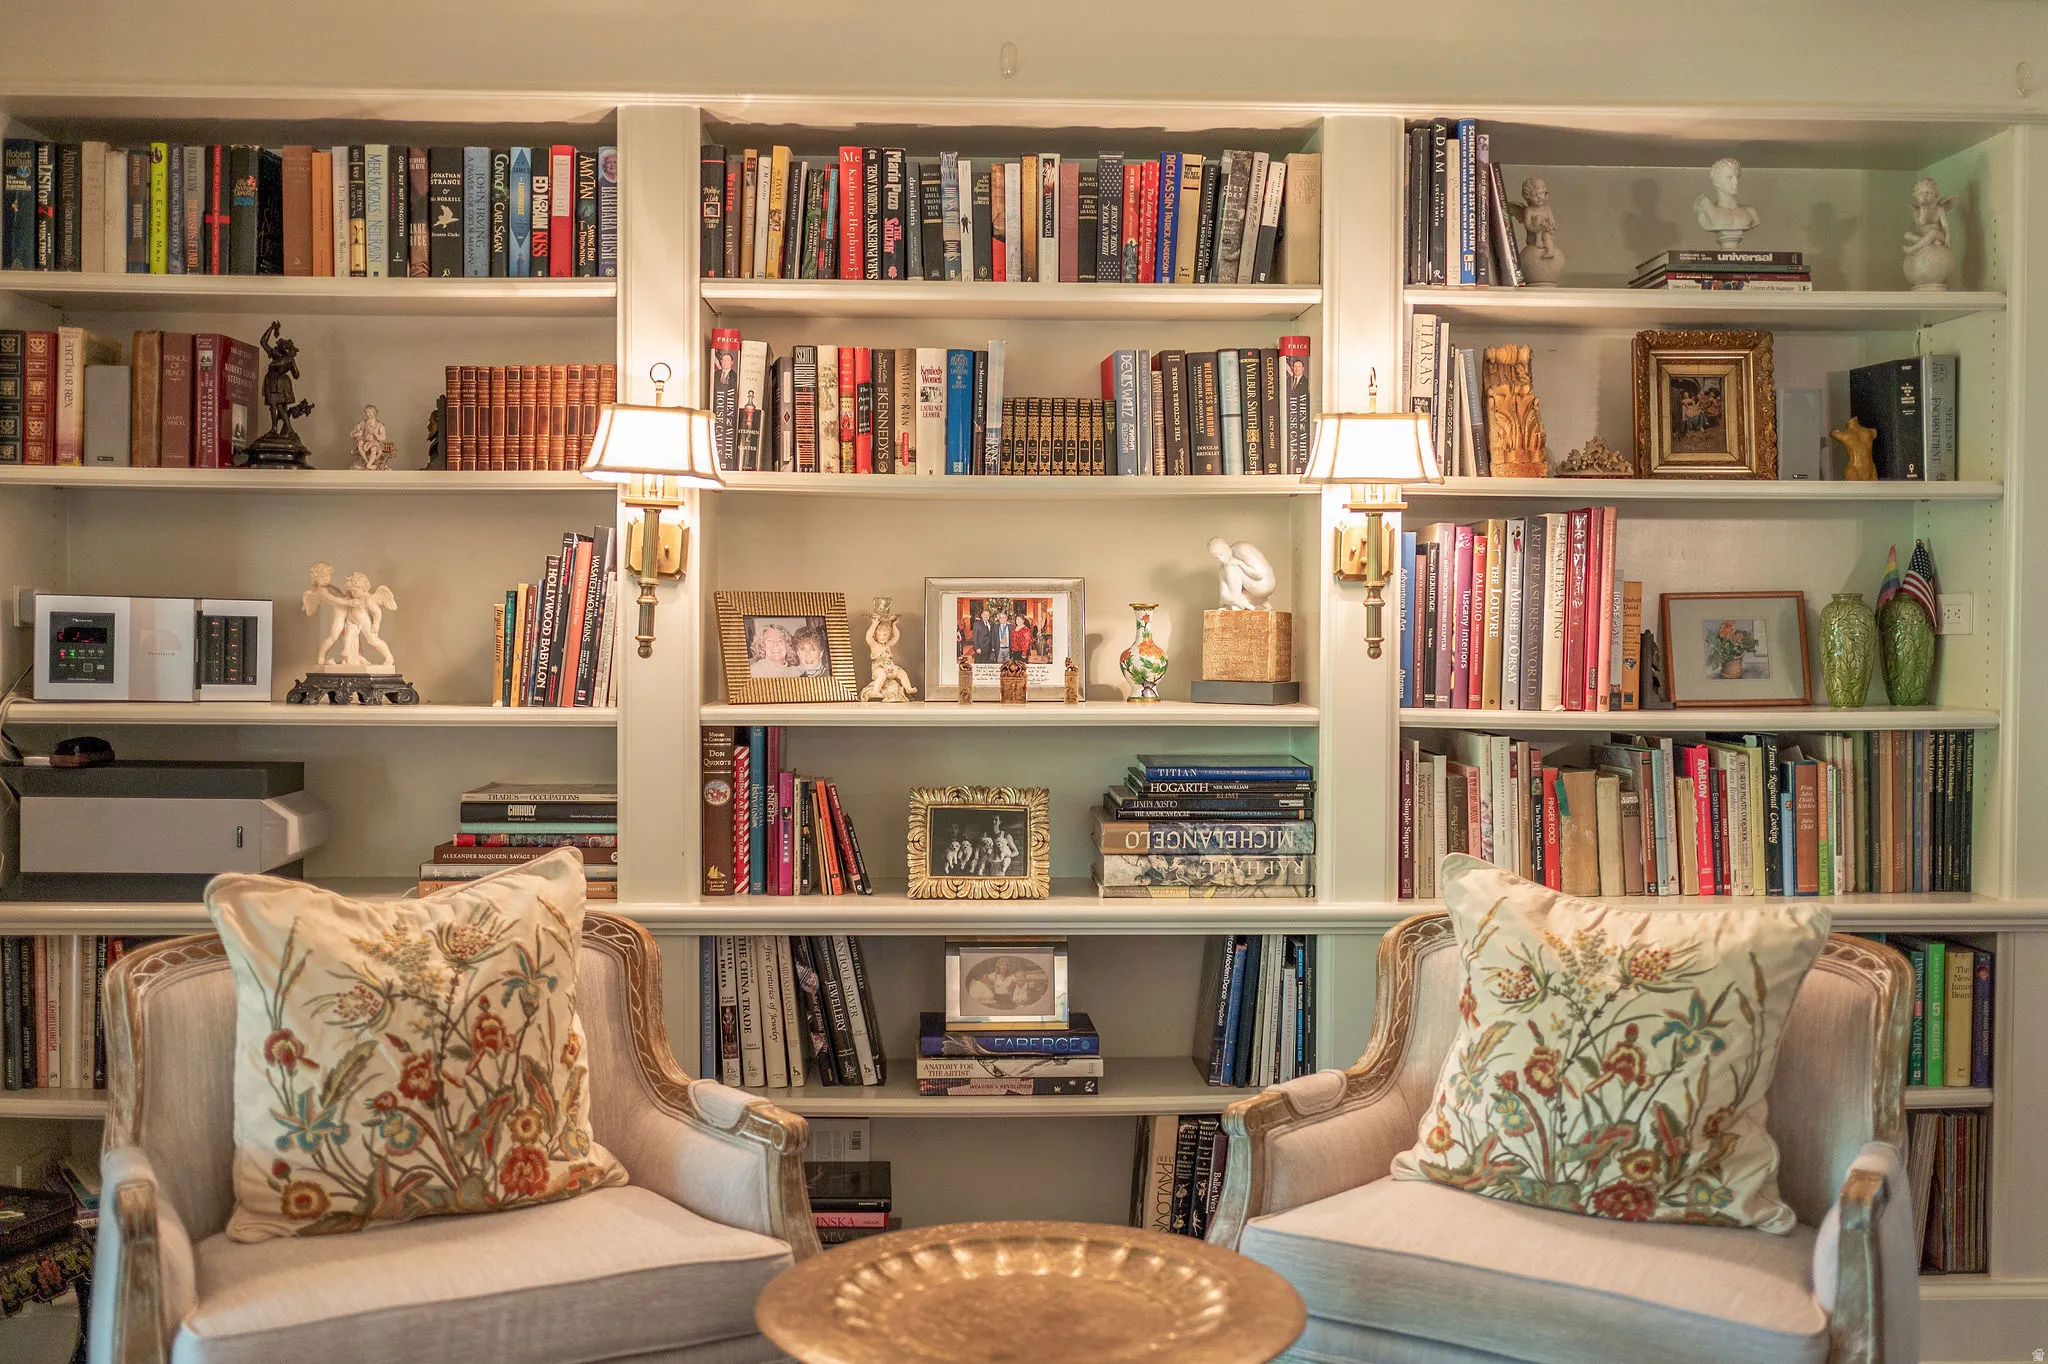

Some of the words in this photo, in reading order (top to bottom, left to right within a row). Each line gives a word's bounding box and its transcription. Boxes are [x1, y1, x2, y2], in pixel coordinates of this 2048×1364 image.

[39, 146, 48, 164] THE
[843, 152, 861, 163] Me
[1435, 124, 1446, 173] ADAM
[39, 164, 53, 191] LIST
[367, 155, 384, 175] MERE
[579, 156, 595, 178] AMY
[867, 164, 878, 184] ANGEL
[885, 151, 901, 182] Mario
[1165, 154, 1177, 179] RICH
[39, 191, 48, 205] OF
[367, 177, 384, 213] MORTALS
[475, 173, 486, 202] JOHN
[532, 176, 548, 192] ED
[579, 179, 595, 199] TAN
[726, 173, 735, 211] Waiting
[848, 169, 857, 216] Katharine
[885, 184, 901, 210] Puzo
[1164, 180, 1176, 192] AS
[38, 205, 53, 217] 7
[494, 202, 505, 224] CARL
[867, 184, 878, 214] GUARDIAN
[1163, 192, 1175, 209] SIN
[39, 220, 47, 240] MARK
[367, 220, 384, 237] NEIL
[475, 208, 486, 248] IRVING
[726, 226, 733, 238] HA
[867, 219, 878, 257] PARETSKY
[884, 218, 898, 253] SICILIAN
[894, 225, 902, 240] THE
[1163, 211, 1174, 237] PATRICK
[39, 241, 47, 265] FROST
[367, 239, 384, 263] RAVIN
[494, 225, 506, 253] SAGAN
[532, 231, 548, 257] KISS
[846, 218, 858, 264] Hepburn
[867, 260, 878, 279] SARA
[1162, 238, 1172, 274] ANDERSON
[1717, 253, 1773, 262] universal
[1420, 321, 1434, 385] TIARAS
[794, 364, 816, 388] TUROW
[1171, 367, 1179, 391] HORSE
[1204, 362, 1214, 404] WILDERNESS
[1245, 363, 1257, 399] WILBUR
[1266, 357, 1274, 402] CLEOPATRA
[715, 391, 724, 423] HOUSE
[725, 389, 734, 417] WHEN
[795, 392, 815, 404] THE
[1121, 389, 1134, 418] WALTZ
[1173, 393, 1181, 425] OCTOBER
[1299, 394, 1307, 422] WHEN
[795, 405, 815, 433] BURDEN
[877, 392, 888, 459] KENNEDYS
[901, 404, 911, 426] RAIN
[1206, 406, 1215, 437] WARRIOR
[1247, 401, 1258, 429] SMITH
[1290, 397, 1298, 429] HOUSE
[724, 429, 733, 459] WHITE
[1931, 397, 1942, 463] ENCHANTMENT
[1248, 443, 1257, 471] QUEST
[1290, 431, 1298, 460] CALLS
[1299, 433, 1307, 464] WHITE
[1531, 524, 1541, 552] ART
[588, 555, 600, 593] WASATCH
[1400, 568, 1408, 608] Adventure
[1490, 564, 1500, 584] THE
[1511, 565, 1519, 585] THE
[543, 568, 558, 635] HOLLYWOOD
[1428, 572, 1436, 612] HERMITAGE
[1474, 572, 1484, 621] PALLADIO
[1528, 554, 1541, 630] TREASURES
[583, 593, 596, 642] MOUNTAINS
[1400, 609, 1407, 617] in
[1460, 589, 1471, 627] Tuscany
[1488, 588, 1502, 638] LOUVRE
[536, 638, 551, 688] BABYLON
[1460, 629, 1470, 669] Interiors
[1527, 645, 1538, 696] WORLD
[1768, 745, 1777, 771] French
[1150, 782, 1209, 792] HOGARTH
[1157, 769, 1197, 777] TITIAN
[1697, 758, 1707, 798] MARION
[767, 785, 775, 824] KNIGHT
[1768, 774, 1778, 809] Regional
[508, 804, 537, 816] CHIHULY
[1403, 798, 1411, 825] Simple
[1534, 814, 1542, 831] Paley's
[1125, 831, 1294, 849] MICHELANGELO
[1548, 823, 1556, 844] FOOD
[1769, 812, 1779, 844] Cooking
[1403, 827, 1411, 859] Suppers
[1203, 860, 1305, 875] RAPHAEL
[738, 937, 746, 958] THE
[763, 945, 774, 962] Five
[739, 961, 749, 995] CHINA
[835, 939, 851, 982] ANTIQUE
[846, 985, 859, 1018] SILVER
[1222, 954, 1233, 980] Modern
[766, 965, 776, 1000] Centuries
[1221, 979, 1230, 999] Dance
[742, 997, 752, 1034] TRADE
[767, 1003, 778, 1011] of
[825, 979, 847, 1031] JEWELLERY
[1932, 1001, 1941, 1017] 5
[48, 1000, 57, 1051] EXHIBITIONISM
[769, 1013, 779, 1043] Jewelry
[1932, 1020, 1940, 1060] INGREDIENTS
[1211, 1172, 1222, 1193] Ballet
[1209, 1194, 1219, 1213] West
